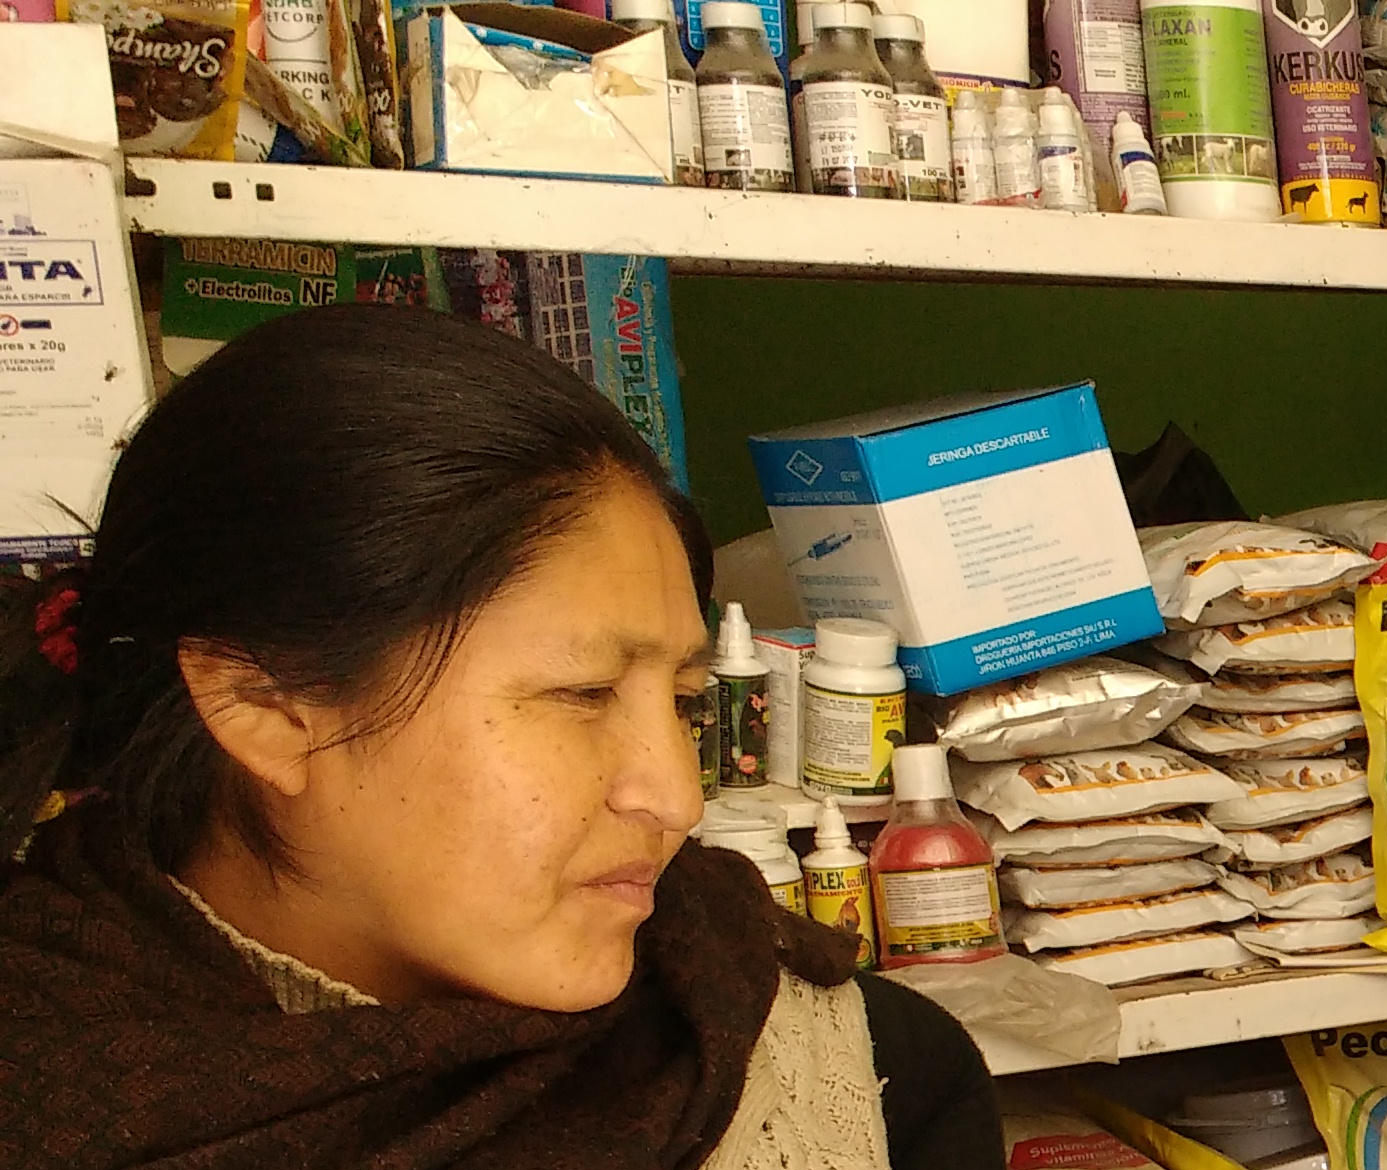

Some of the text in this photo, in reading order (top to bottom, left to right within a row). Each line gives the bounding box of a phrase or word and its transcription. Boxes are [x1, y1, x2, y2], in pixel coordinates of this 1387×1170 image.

[276, 71, 330, 85] RKING
[1274, 50, 1365, 83] KERKUS
[861, 89, 894, 100] YOD
[302, 279, 336, 305] NF
[928, 427, 1049, 466] JERINGA DESCARTABLE
